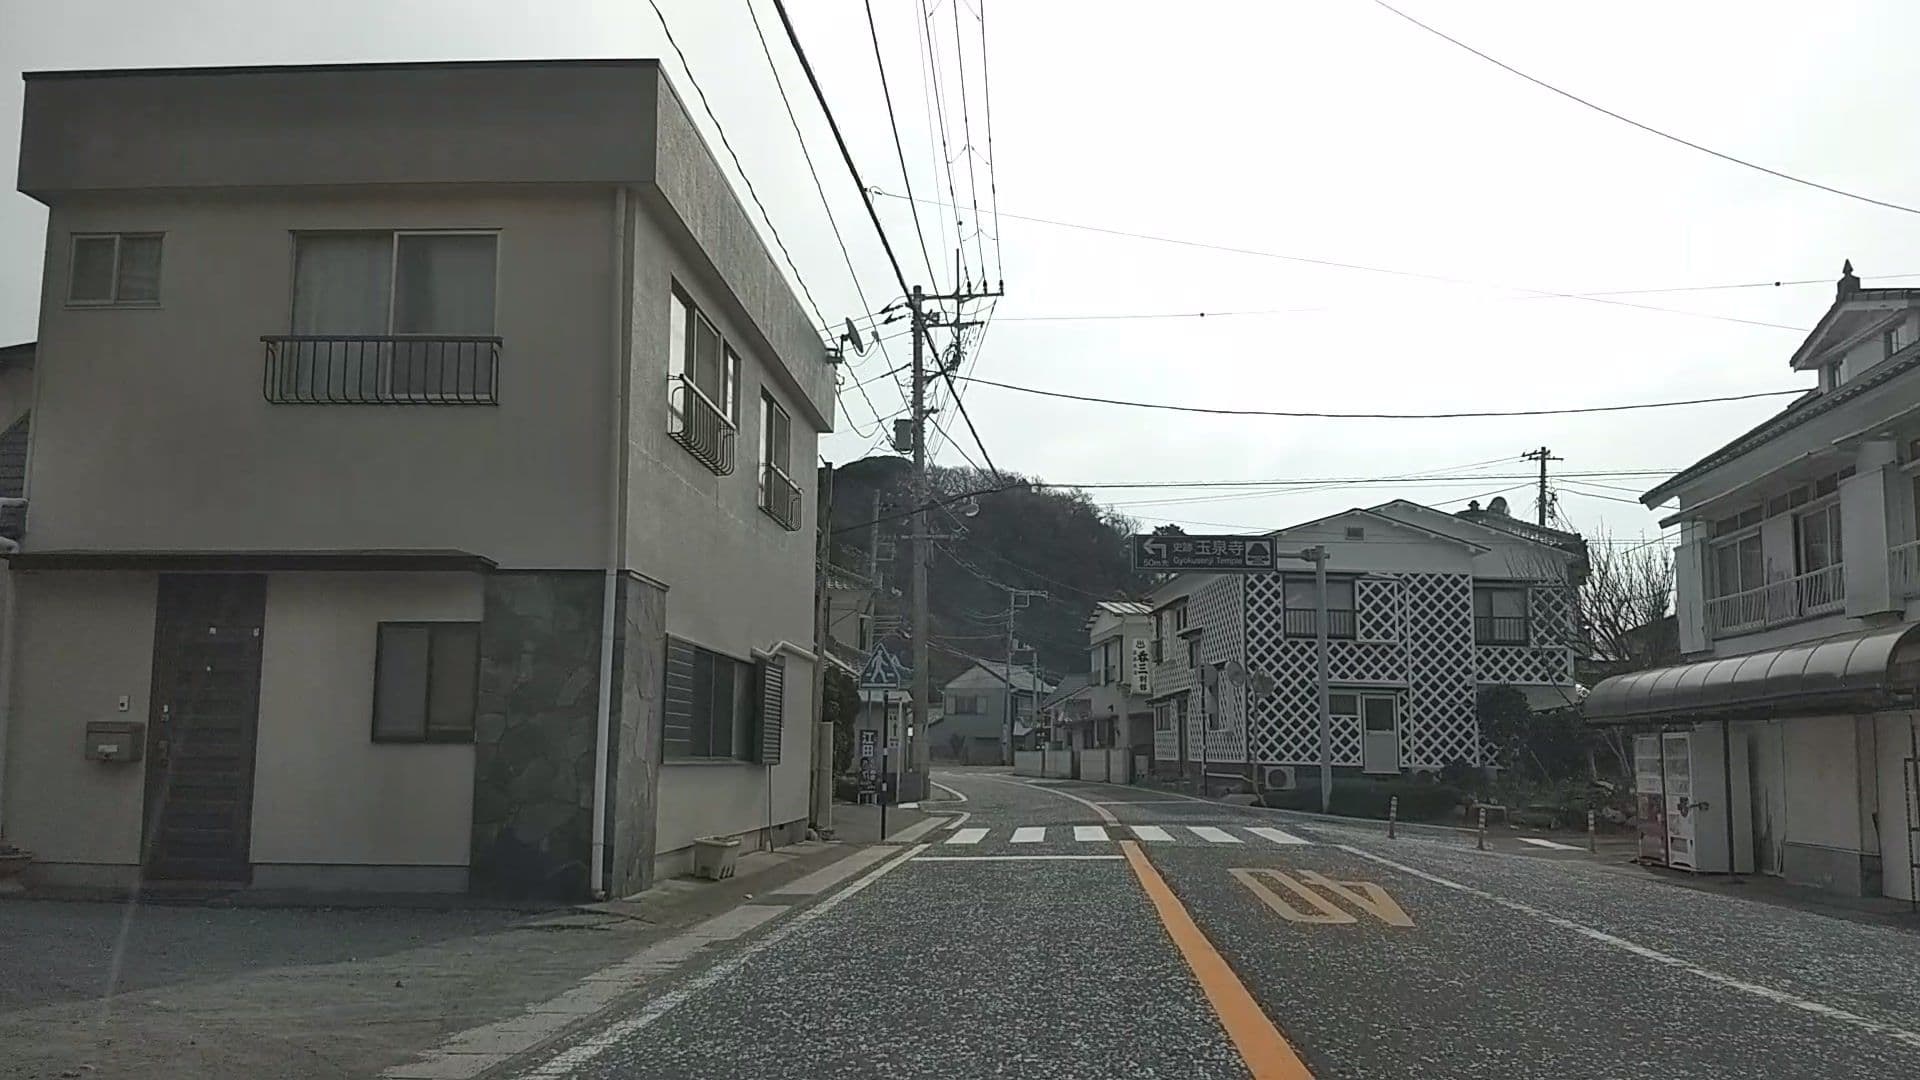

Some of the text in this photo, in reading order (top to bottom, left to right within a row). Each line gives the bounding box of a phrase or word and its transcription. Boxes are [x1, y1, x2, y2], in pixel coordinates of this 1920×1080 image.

[1195, 540, 1244, 556] 玉泉寺
[1216, 556, 1242, 566] Temple
